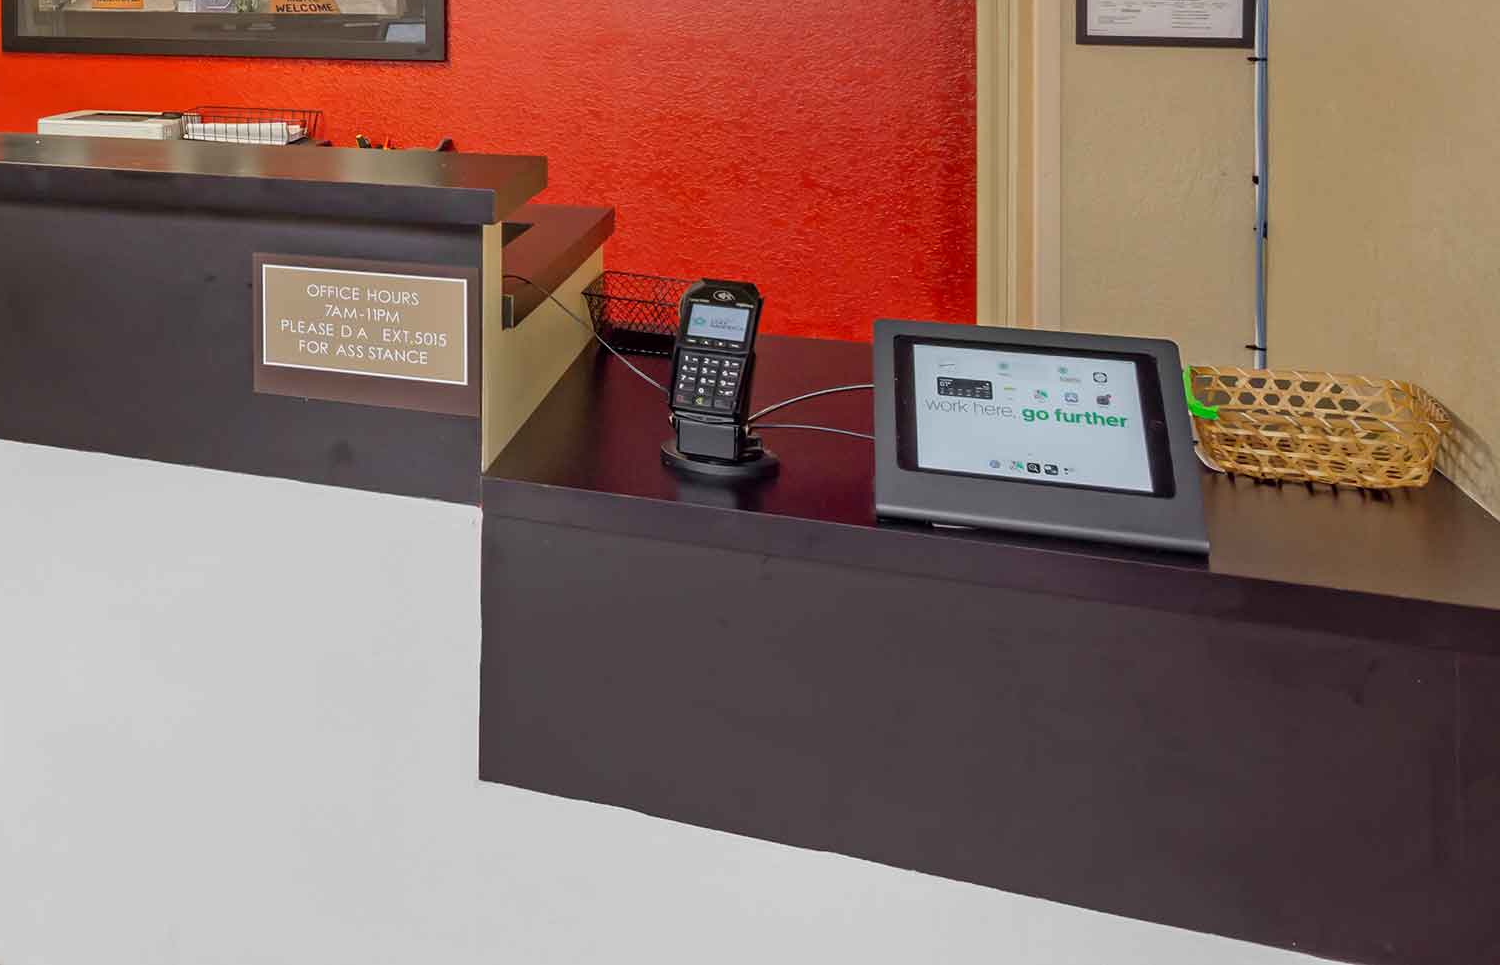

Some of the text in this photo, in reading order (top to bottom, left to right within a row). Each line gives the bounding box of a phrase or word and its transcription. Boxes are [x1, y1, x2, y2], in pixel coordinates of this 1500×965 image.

[275, 2, 333, 13] WELCOME
[306, 283, 420, 306] OFFICE HOURS
[324, 304, 400, 323] 7AM-11PM
[280, 319, 335, 337] PLEASE
[383, 328, 448, 348] EXT.5015
[298, 339, 329, 356] FOR
[924, 398, 968, 413] work
[1021, 407, 1049, 423] go
[1054, 407, 1129, 428] further
